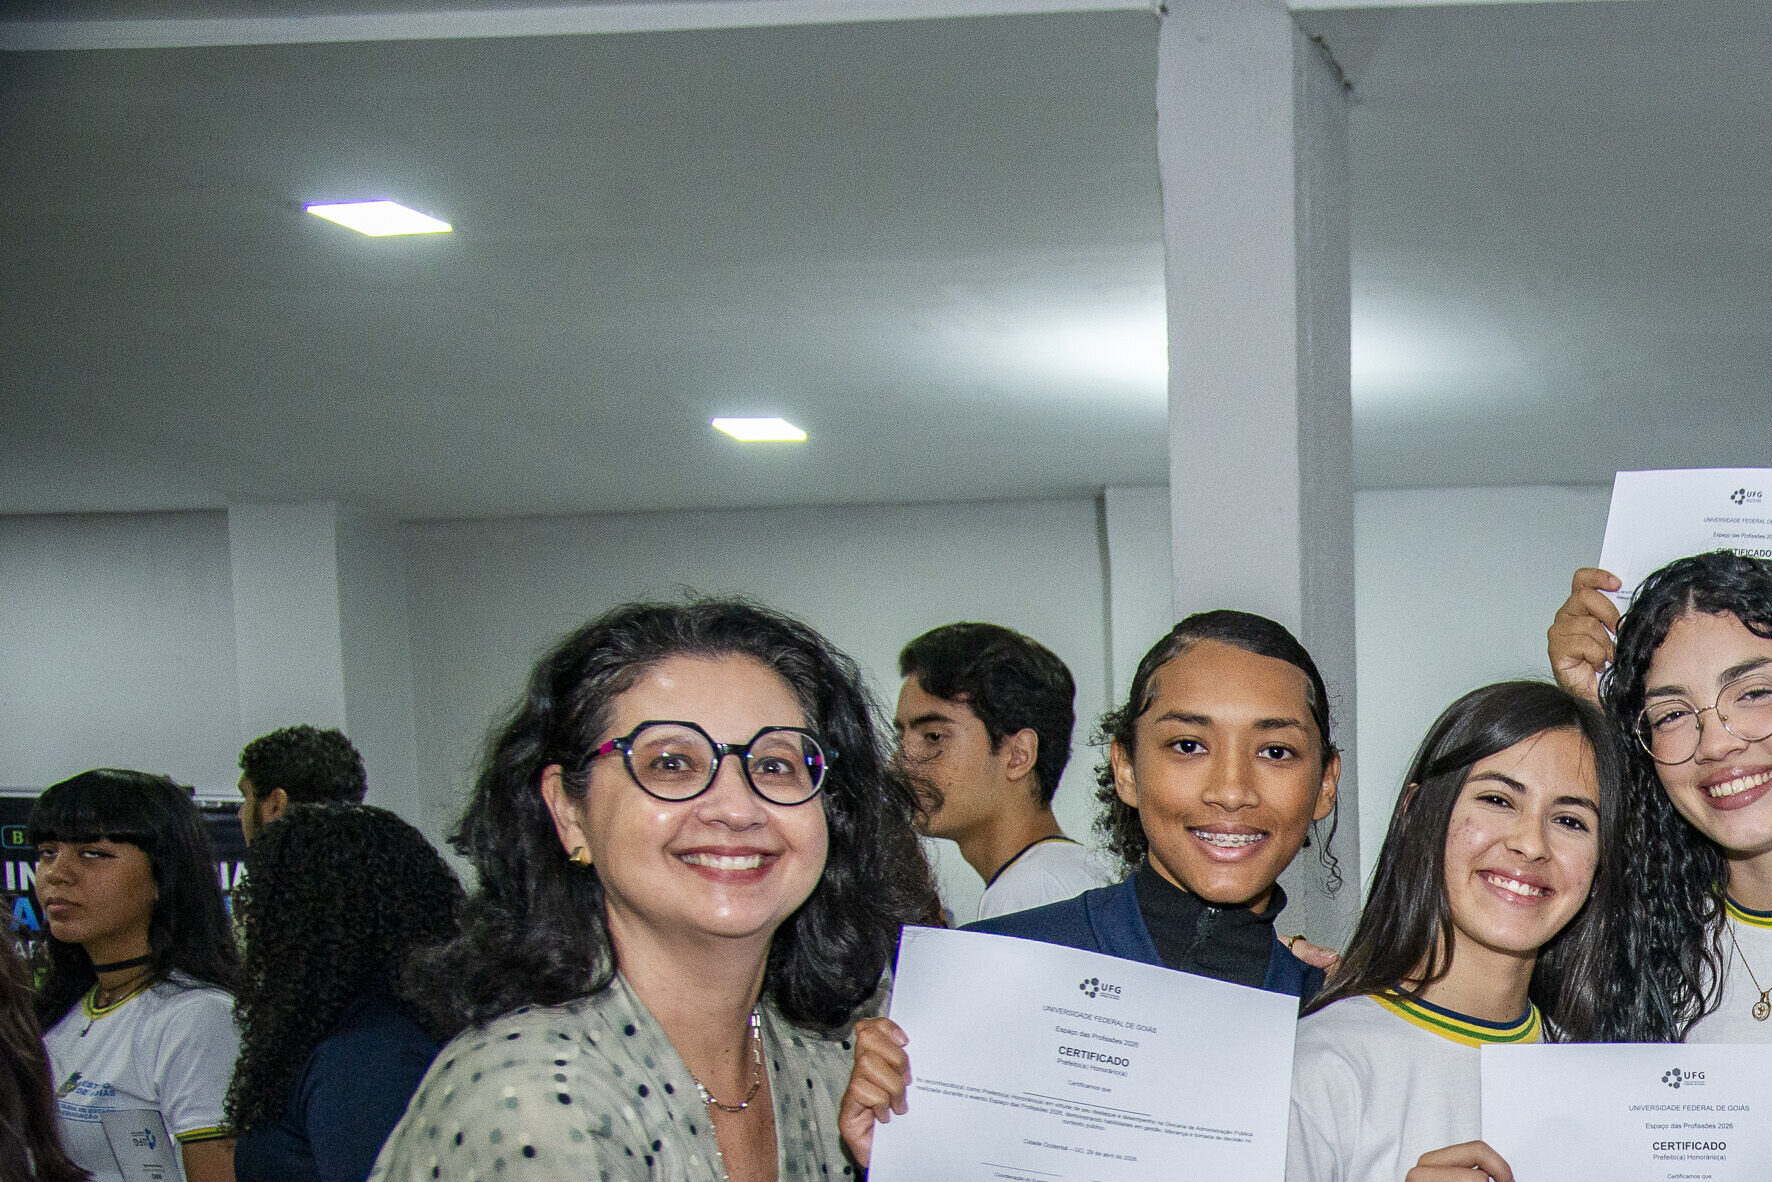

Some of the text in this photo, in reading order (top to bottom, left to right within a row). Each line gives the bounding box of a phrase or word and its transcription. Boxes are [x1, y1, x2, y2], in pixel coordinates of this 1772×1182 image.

[1101, 984, 1121, 994] UFG
[1043, 1005, 1092, 1020] UNIVERSIDADE
[1094, 1016, 1124, 1028] FEDERAL
[1126, 1022, 1135, 1030] DE
[1058, 1046, 1130, 1067] CERTIFICADO
[1728, 1104, 1750, 1112] GOIÁS
[1652, 1142, 1726, 1150] CERTIFICADO
